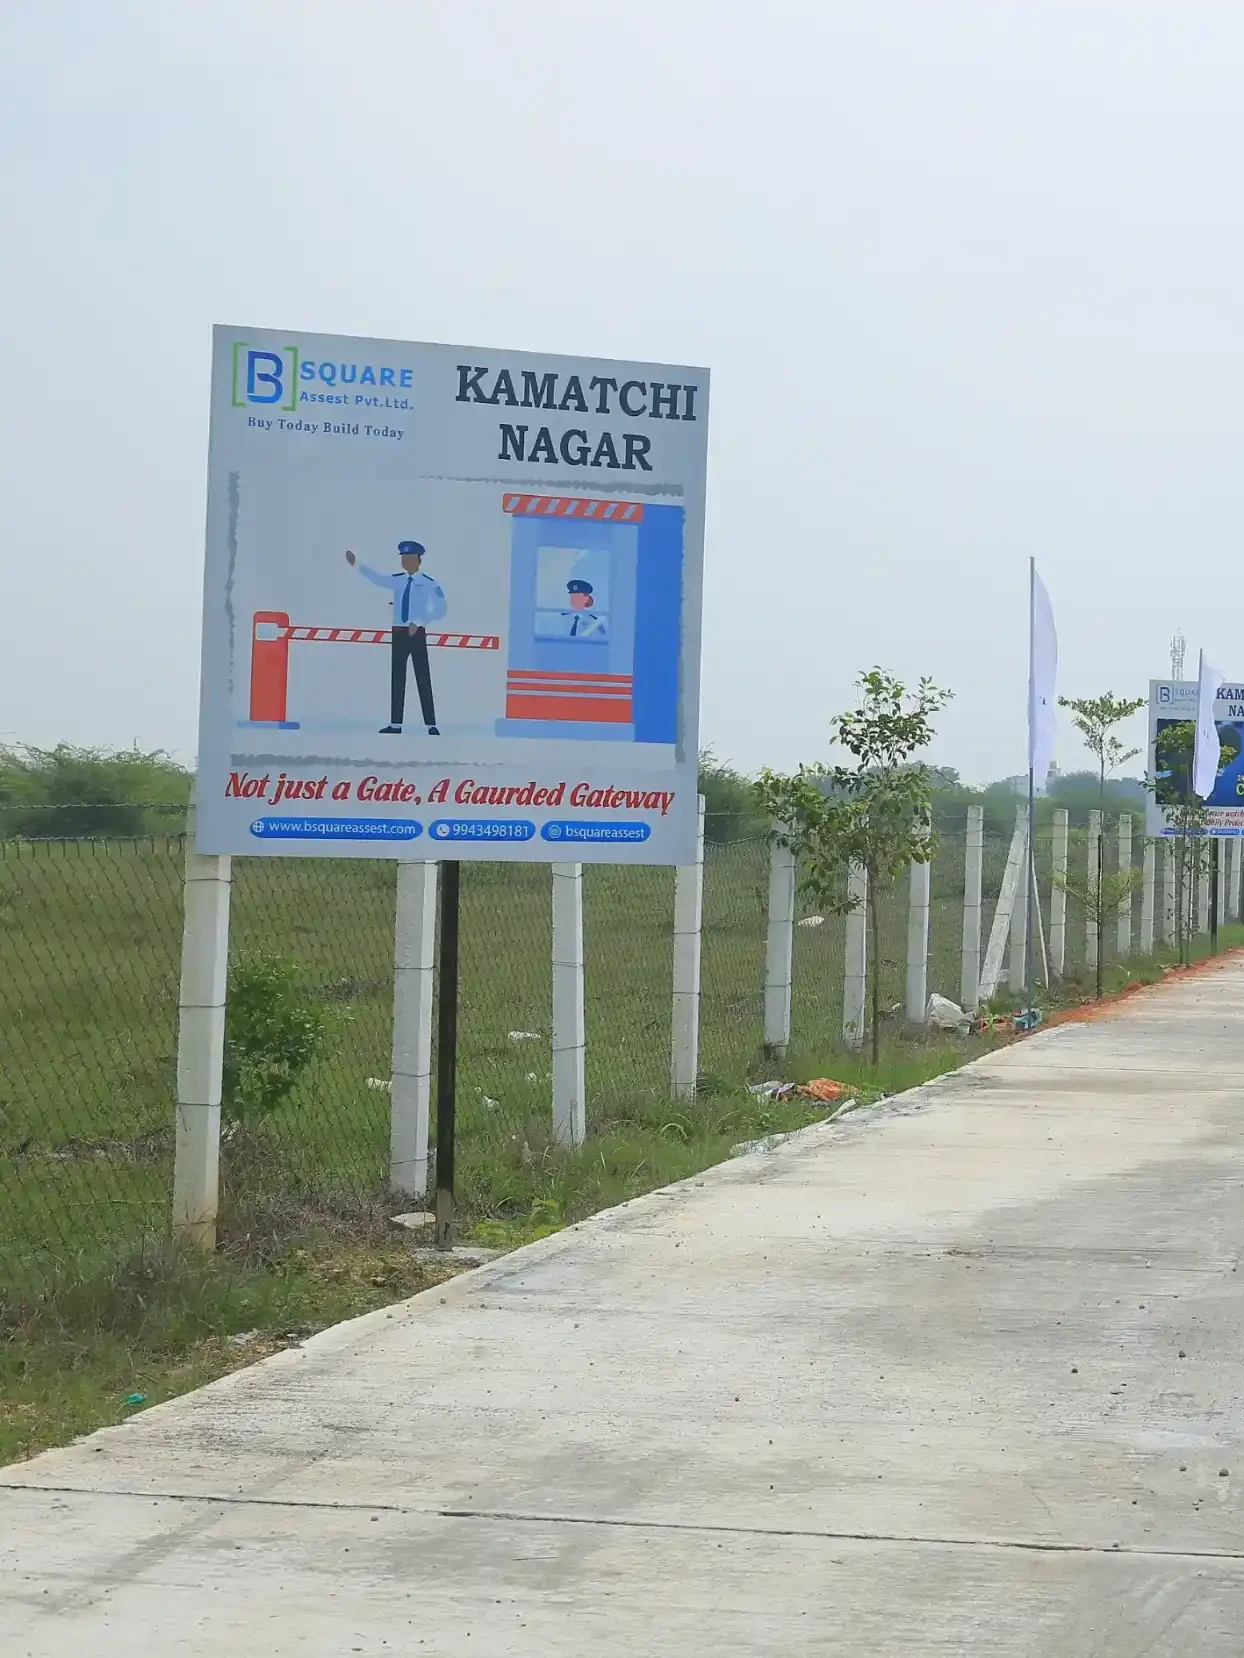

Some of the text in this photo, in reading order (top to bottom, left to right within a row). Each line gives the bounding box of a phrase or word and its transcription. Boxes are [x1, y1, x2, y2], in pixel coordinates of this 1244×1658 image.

[300, 361, 414, 388] SQUARE
[300, 391, 414, 410] Assest Pvt.Ltd.
[456, 365, 698, 421] KAMATCHI
[248, 416, 405, 440] Buy Today Build Today
[498, 423, 653, 471] NAGAR
[225, 771, 676, 816] Not just a Gate, A Gaurded Gateway
[269, 820, 416, 835] www.bsquareassest.com
[453, 823, 529, 837] 9943498181
[565, 824, 645, 840] bsquareassest
